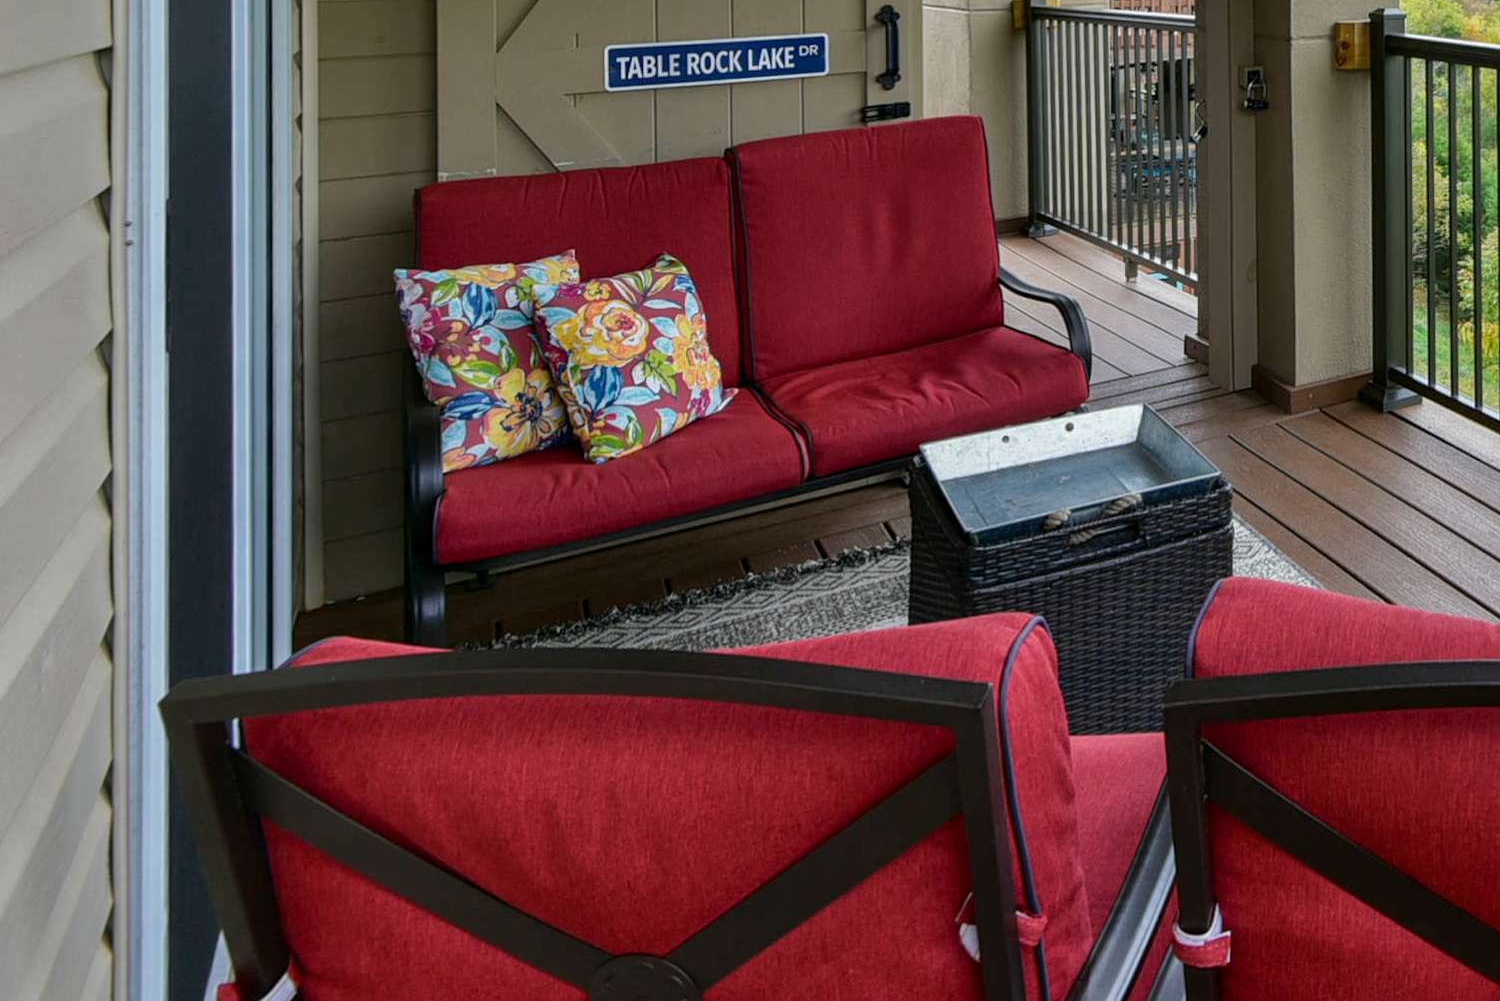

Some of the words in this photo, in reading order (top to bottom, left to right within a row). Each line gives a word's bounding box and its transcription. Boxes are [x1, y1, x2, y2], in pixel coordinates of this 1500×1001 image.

[616, 54, 681, 80] TABLE
[687, 50, 743, 76] ROCK
[748, 47, 795, 71] LAKE
[799, 44, 819, 57] DR
